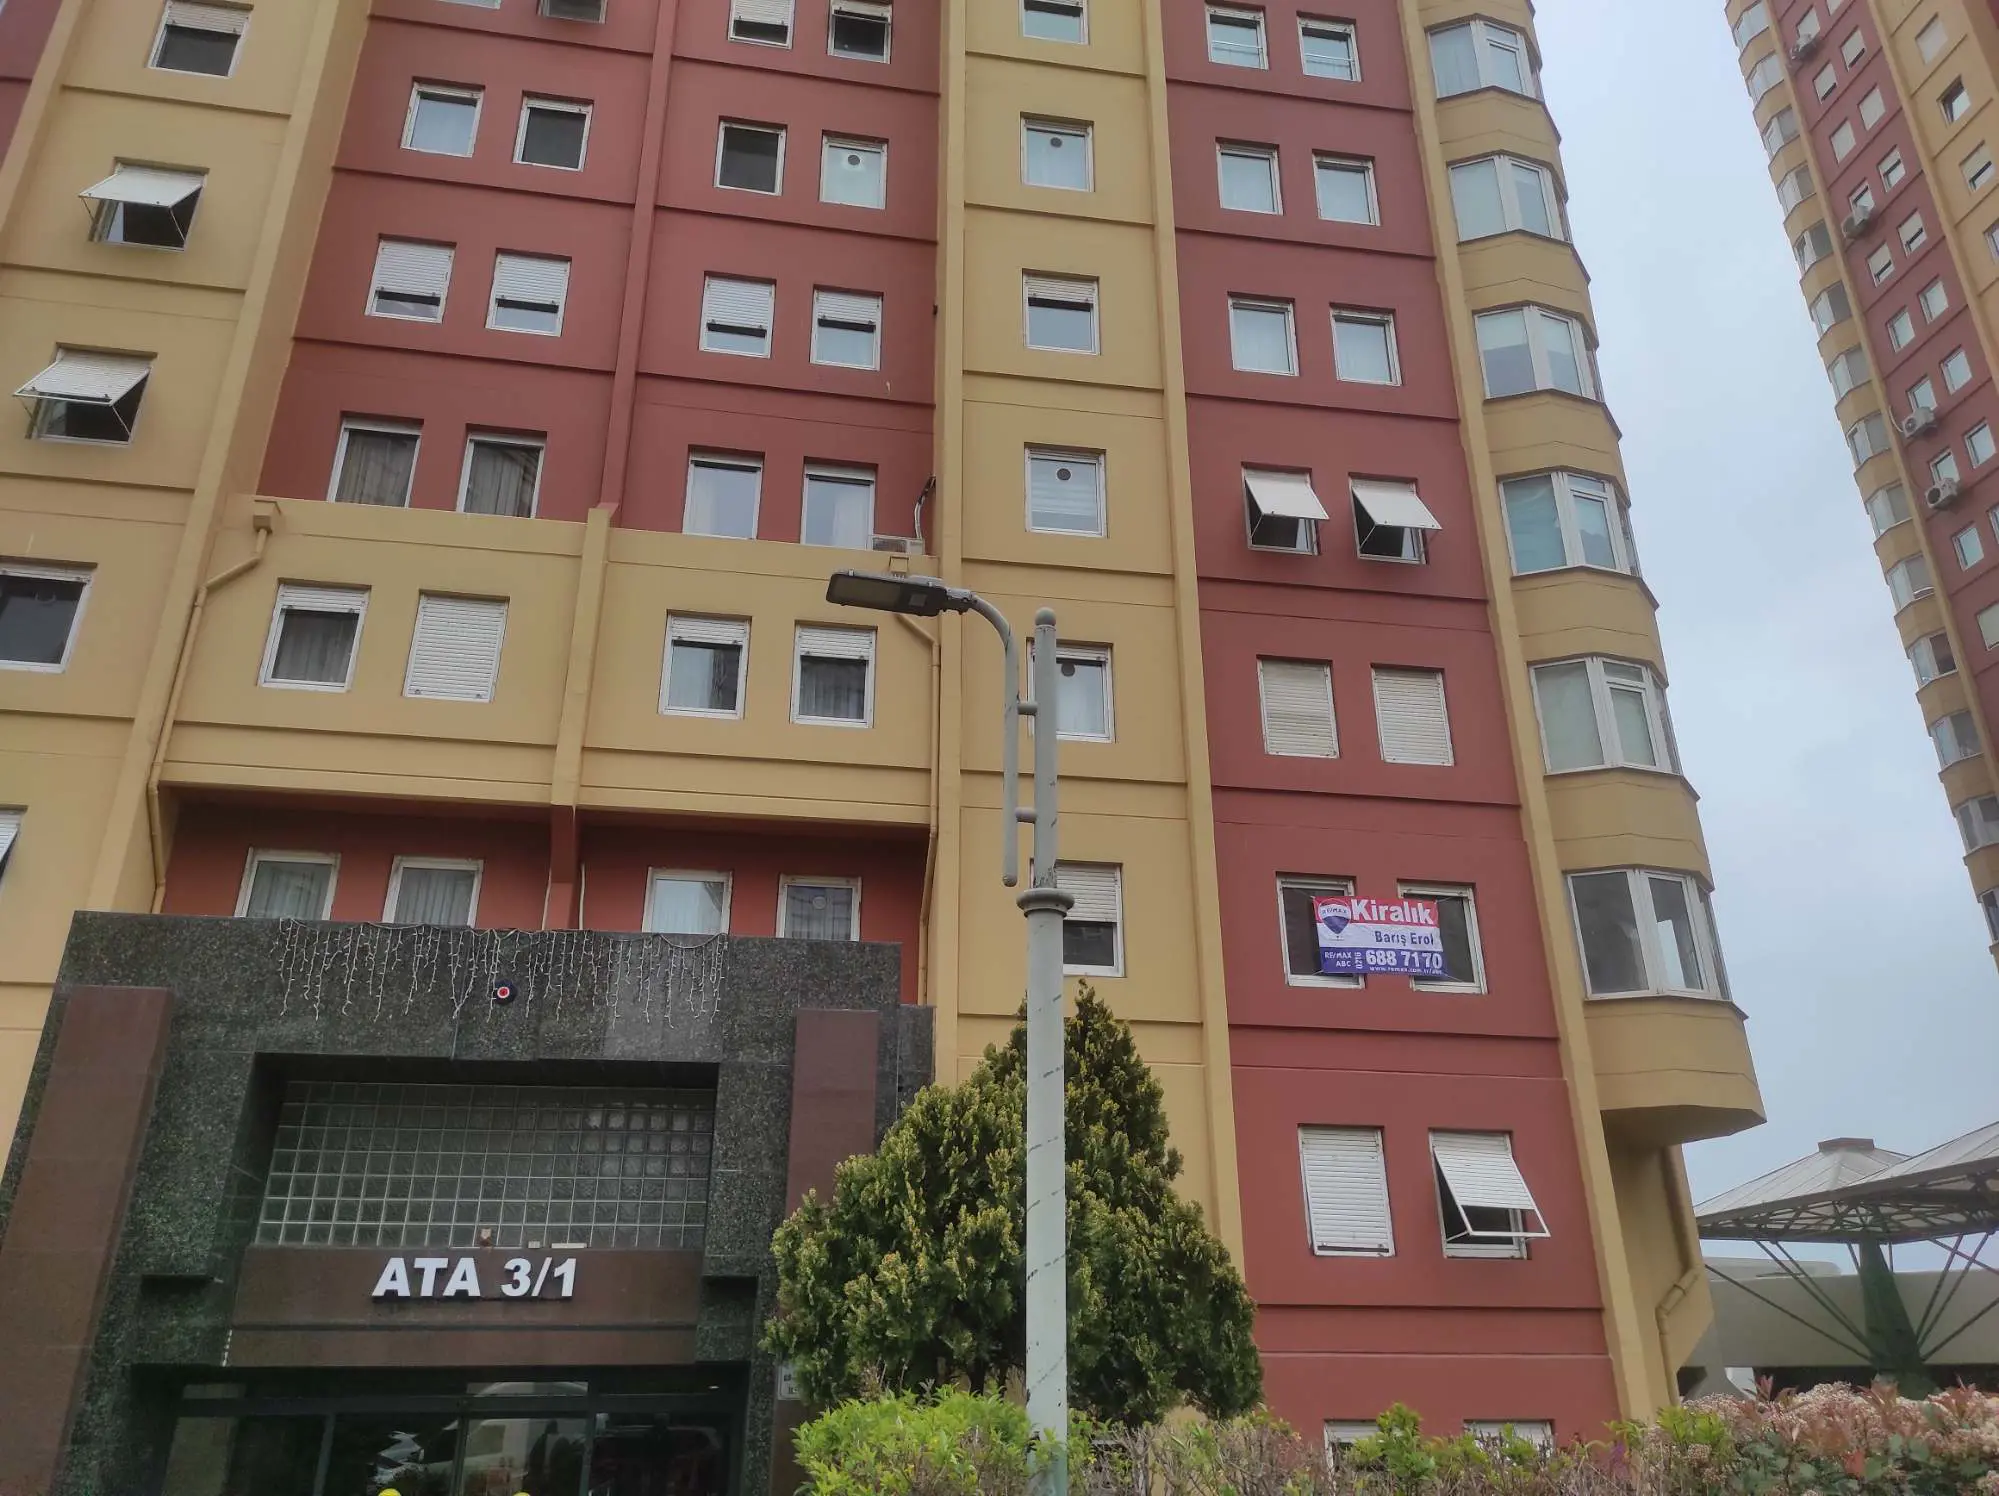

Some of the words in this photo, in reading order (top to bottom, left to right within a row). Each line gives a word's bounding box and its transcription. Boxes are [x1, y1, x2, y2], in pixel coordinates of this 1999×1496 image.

[1351, 899, 1434, 924] Kiralık
[1375, 931, 1407, 946] Barış
[1410, 932, 1434, 945] Erol
[1324, 951, 1352, 959] RE/MAX
[1365, 949, 1397, 966] 688
[1336, 960, 1352, 968] ABC
[371, 1257, 481, 1297] ATA
[500, 1256, 577, 1297] 3/1
